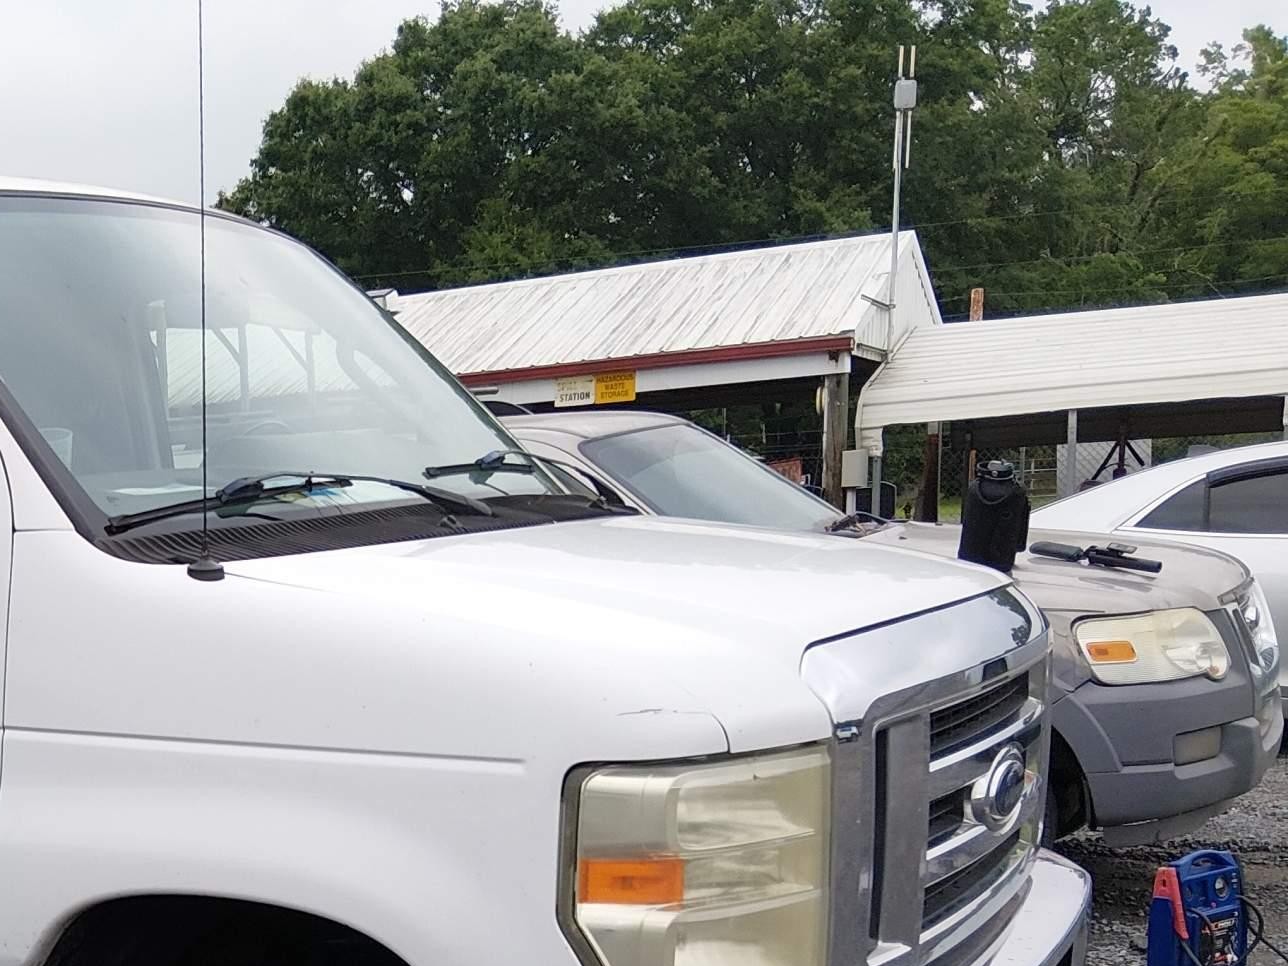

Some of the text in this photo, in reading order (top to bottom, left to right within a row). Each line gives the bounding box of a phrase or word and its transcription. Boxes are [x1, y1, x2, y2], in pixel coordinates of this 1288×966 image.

[597, 374, 633, 384] HAZARDOUS
[605, 383, 625, 391] WASTE
[559, 392, 591, 402] STATION
[600, 391, 629, 399] STORAGE
